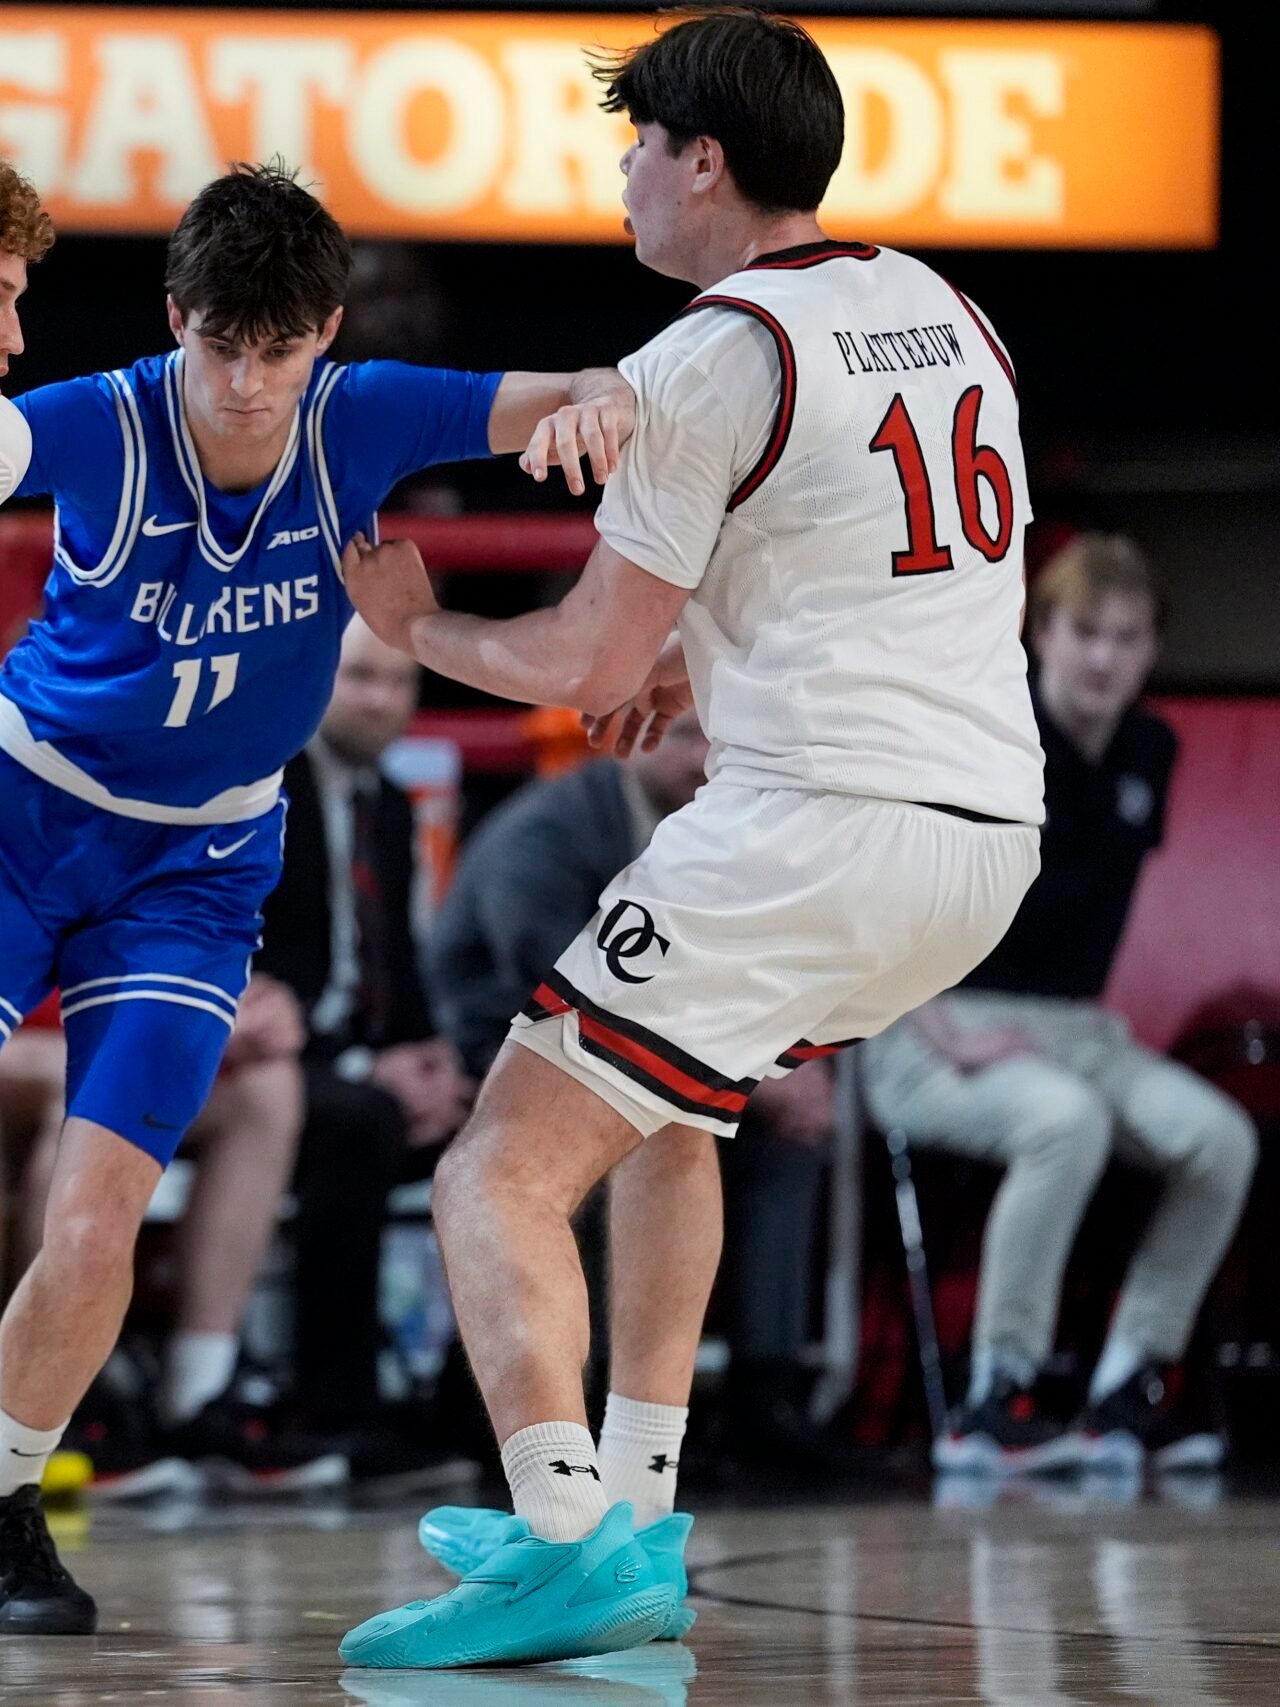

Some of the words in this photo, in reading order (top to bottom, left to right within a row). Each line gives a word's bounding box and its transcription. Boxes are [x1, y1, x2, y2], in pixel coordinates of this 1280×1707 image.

[832, 323, 966, 376] PLATTEEUW
[868, 384, 1014, 578] 16
[163, 652, 240, 728] 11
[597, 898, 671, 984] DC
